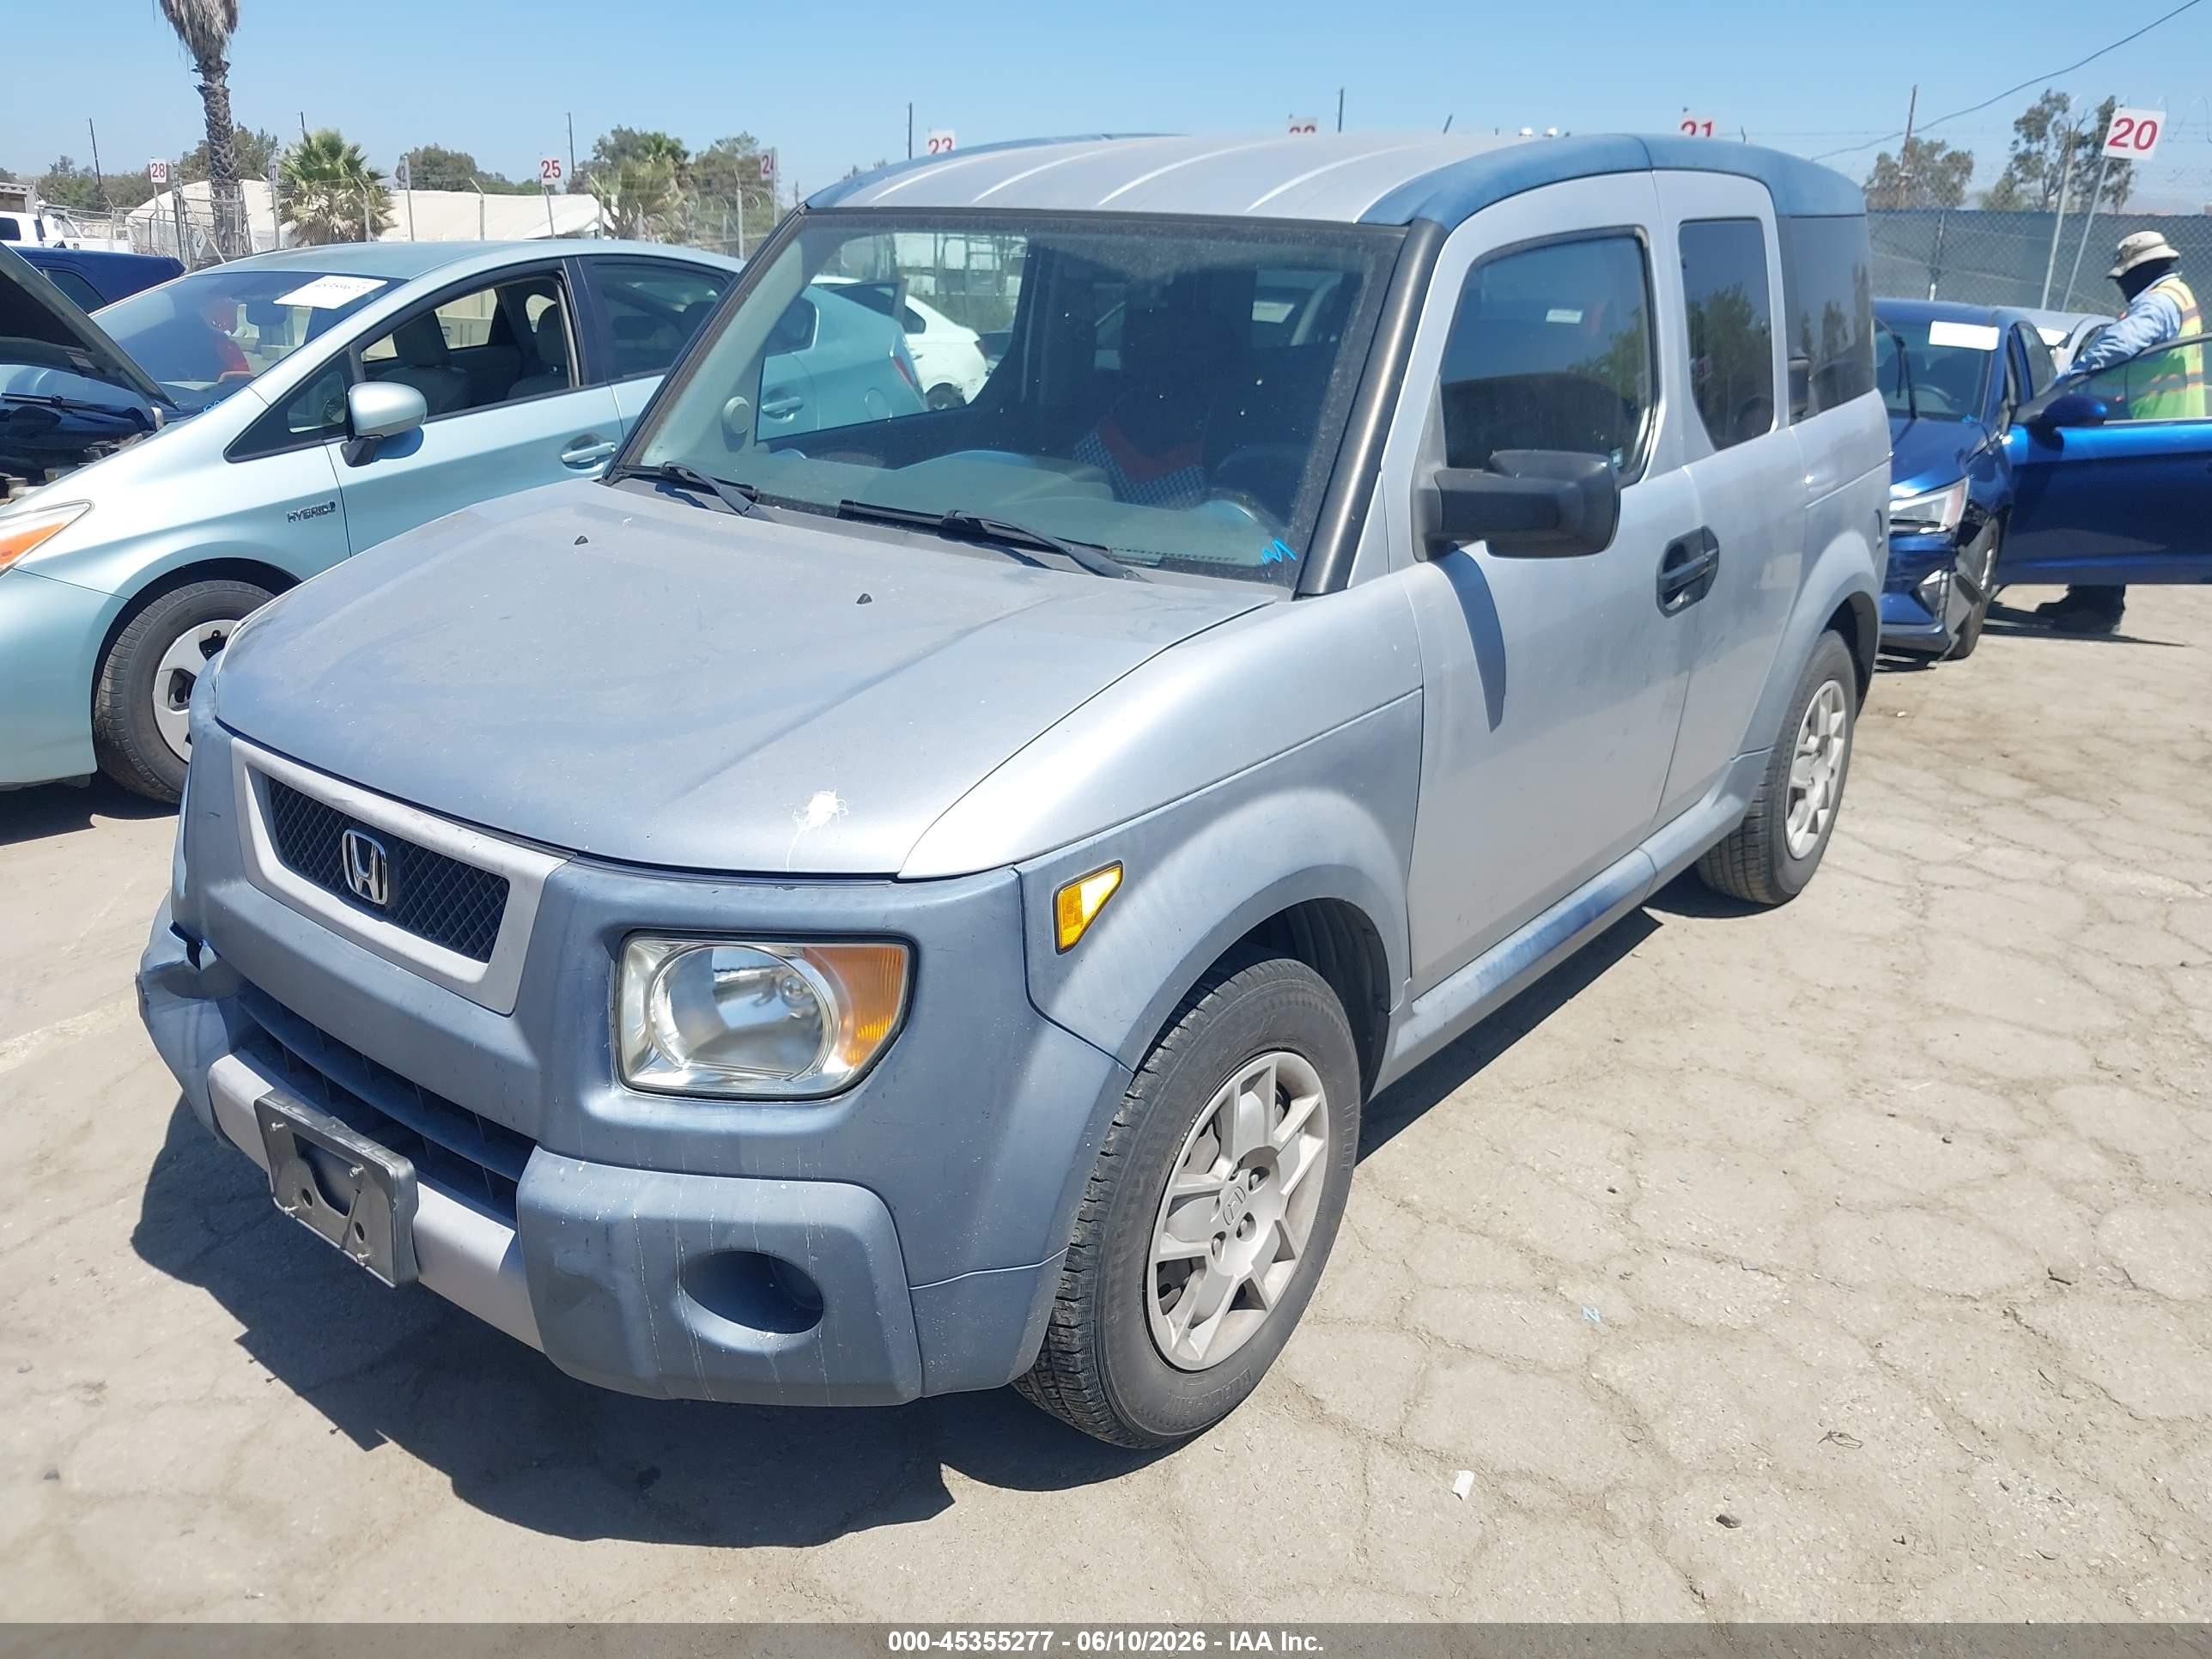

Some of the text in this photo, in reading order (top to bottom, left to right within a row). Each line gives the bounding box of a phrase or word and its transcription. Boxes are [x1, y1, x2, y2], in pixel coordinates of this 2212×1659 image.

[2108, 118, 2158, 150] 20
[928, 137, 952, 155] 23
[151, 163, 166, 178] 28
[269, 164, 276, 181] 27
[541, 160, 562, 179] 25
[287, 501, 336, 522] HYBRID
